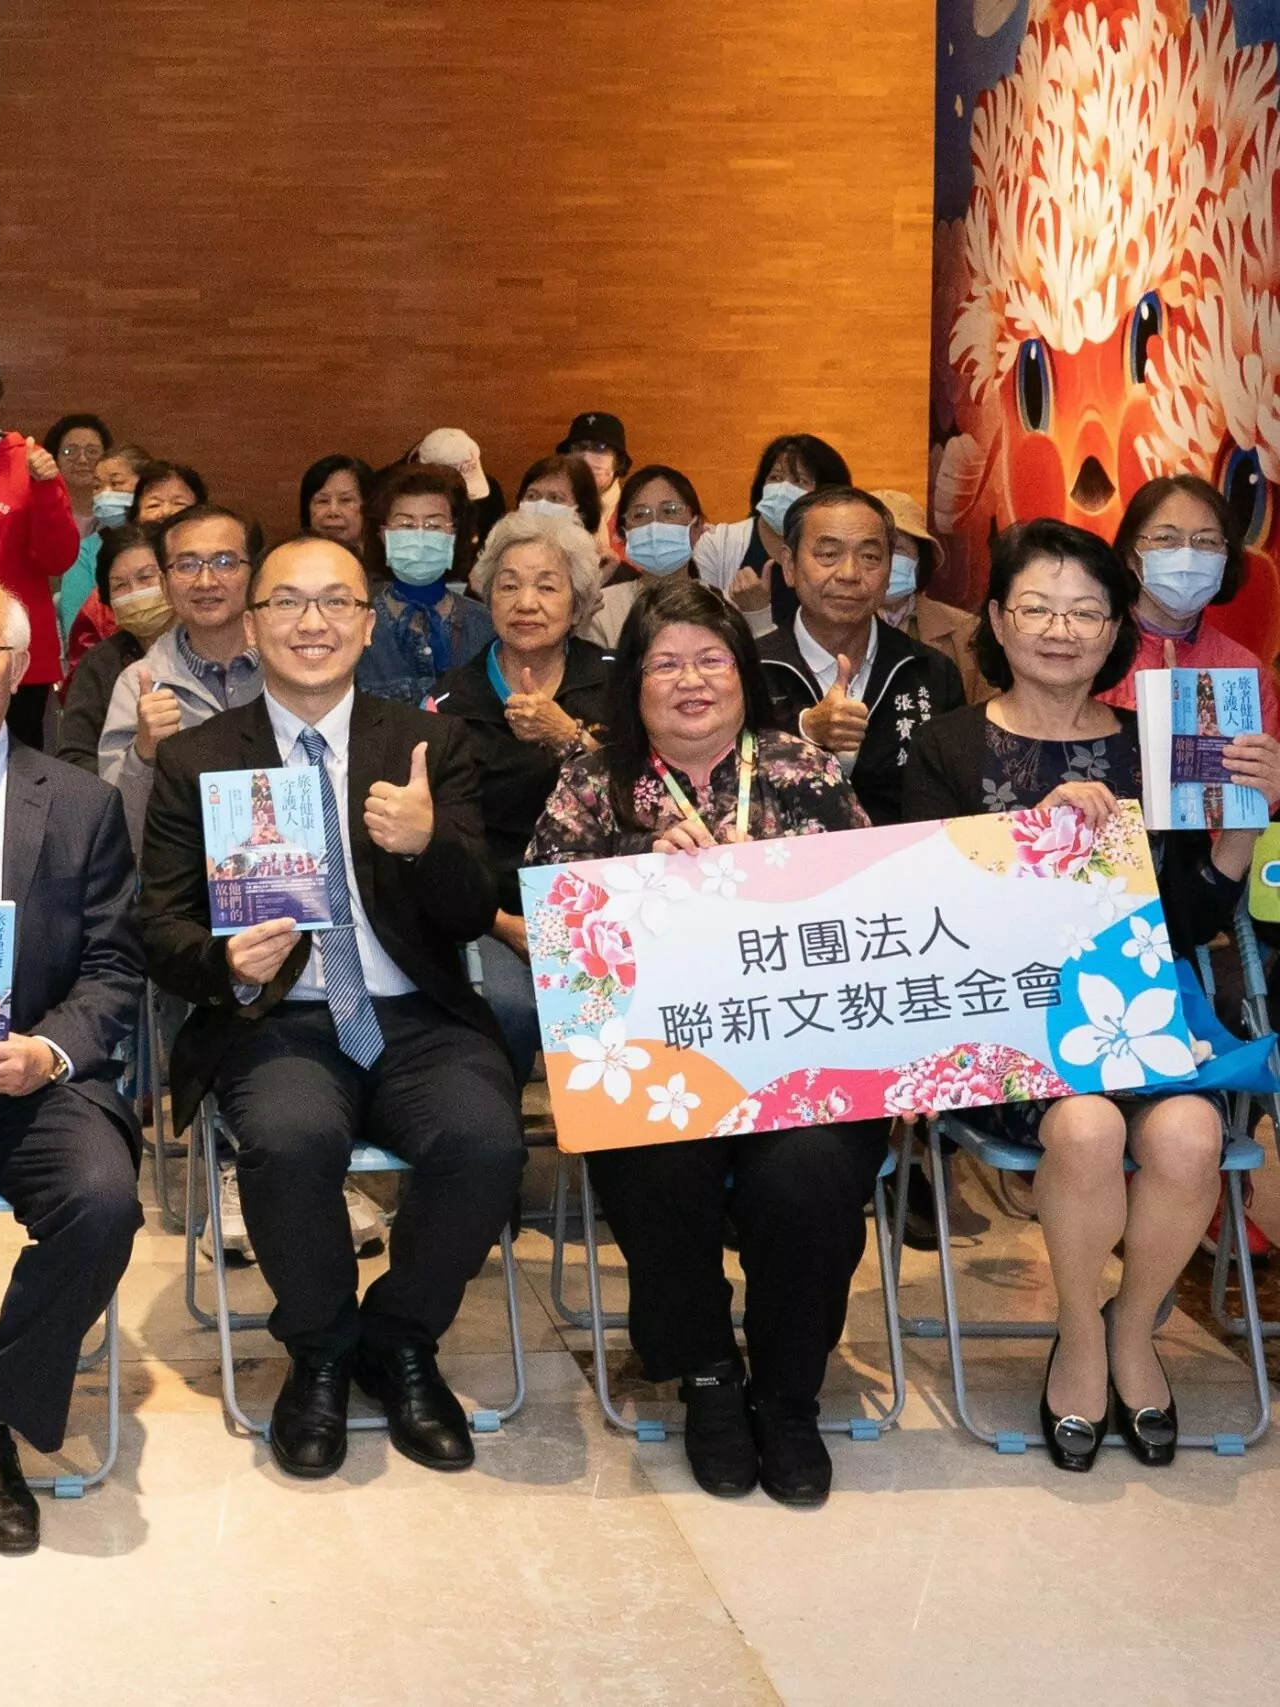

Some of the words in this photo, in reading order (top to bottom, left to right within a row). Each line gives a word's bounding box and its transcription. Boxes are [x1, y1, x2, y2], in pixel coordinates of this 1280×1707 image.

[737, 905, 971, 976] 財團法人
[658, 961, 1064, 1052] 聯新文教基金會
